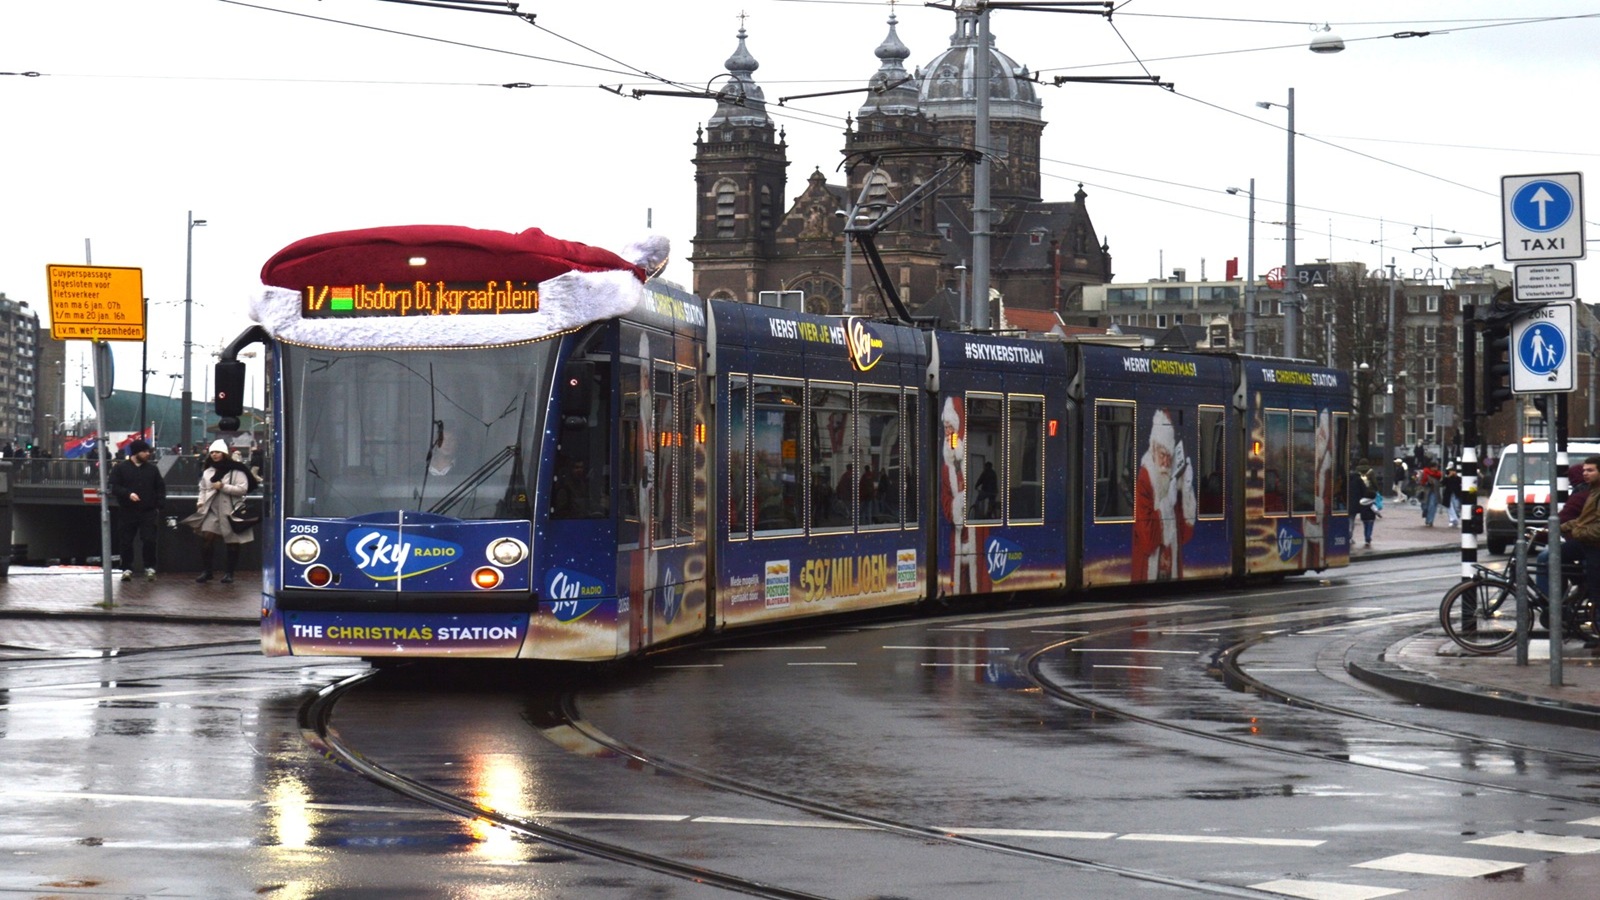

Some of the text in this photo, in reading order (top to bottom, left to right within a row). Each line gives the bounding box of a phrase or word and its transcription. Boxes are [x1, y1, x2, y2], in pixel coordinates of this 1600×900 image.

[1520, 237, 1565, 251] TAXI
[52, 268, 112, 280] Cuyperspassage
[53, 280, 110, 289] afgesloten voor
[53, 289, 100, 298] fietsverkeer
[415, 280, 538, 316] Dijkgraafplein
[54, 300, 69, 308] van
[83, 300, 90, 308] 6
[91, 301, 105, 311] jan.
[106, 301, 121, 310] 07h
[55, 311, 72, 319] t/m
[86, 311, 96, 320] 20
[97, 312, 110, 322] jan.
[113, 312, 126, 320] 16h
[1529, 310, 1555, 319] ZONE
[80, 326, 141, 336] werkzaamheden
[769, 317, 847, 346] KERST VIER JE MET
[964, 342, 1044, 365] #SKYKERSTTRAM
[1123, 357, 1197, 377] MERRY CHRISTMAS!
[1261, 368, 1338, 387] THE CHRISTMAS STATION
[1048, 420, 1057, 436] 17
[289, 524, 319, 534] 2058
[355, 531, 411, 573] Sky
[414, 547, 456, 557] RADIO
[987, 539, 1008, 576] Sky
[831, 553, 887, 598] MILJOEN
[550, 571, 581, 615] Sky
[581, 587, 602, 595] RADIO
[293, 625, 517, 640] THE CHRISTMAS STATION
